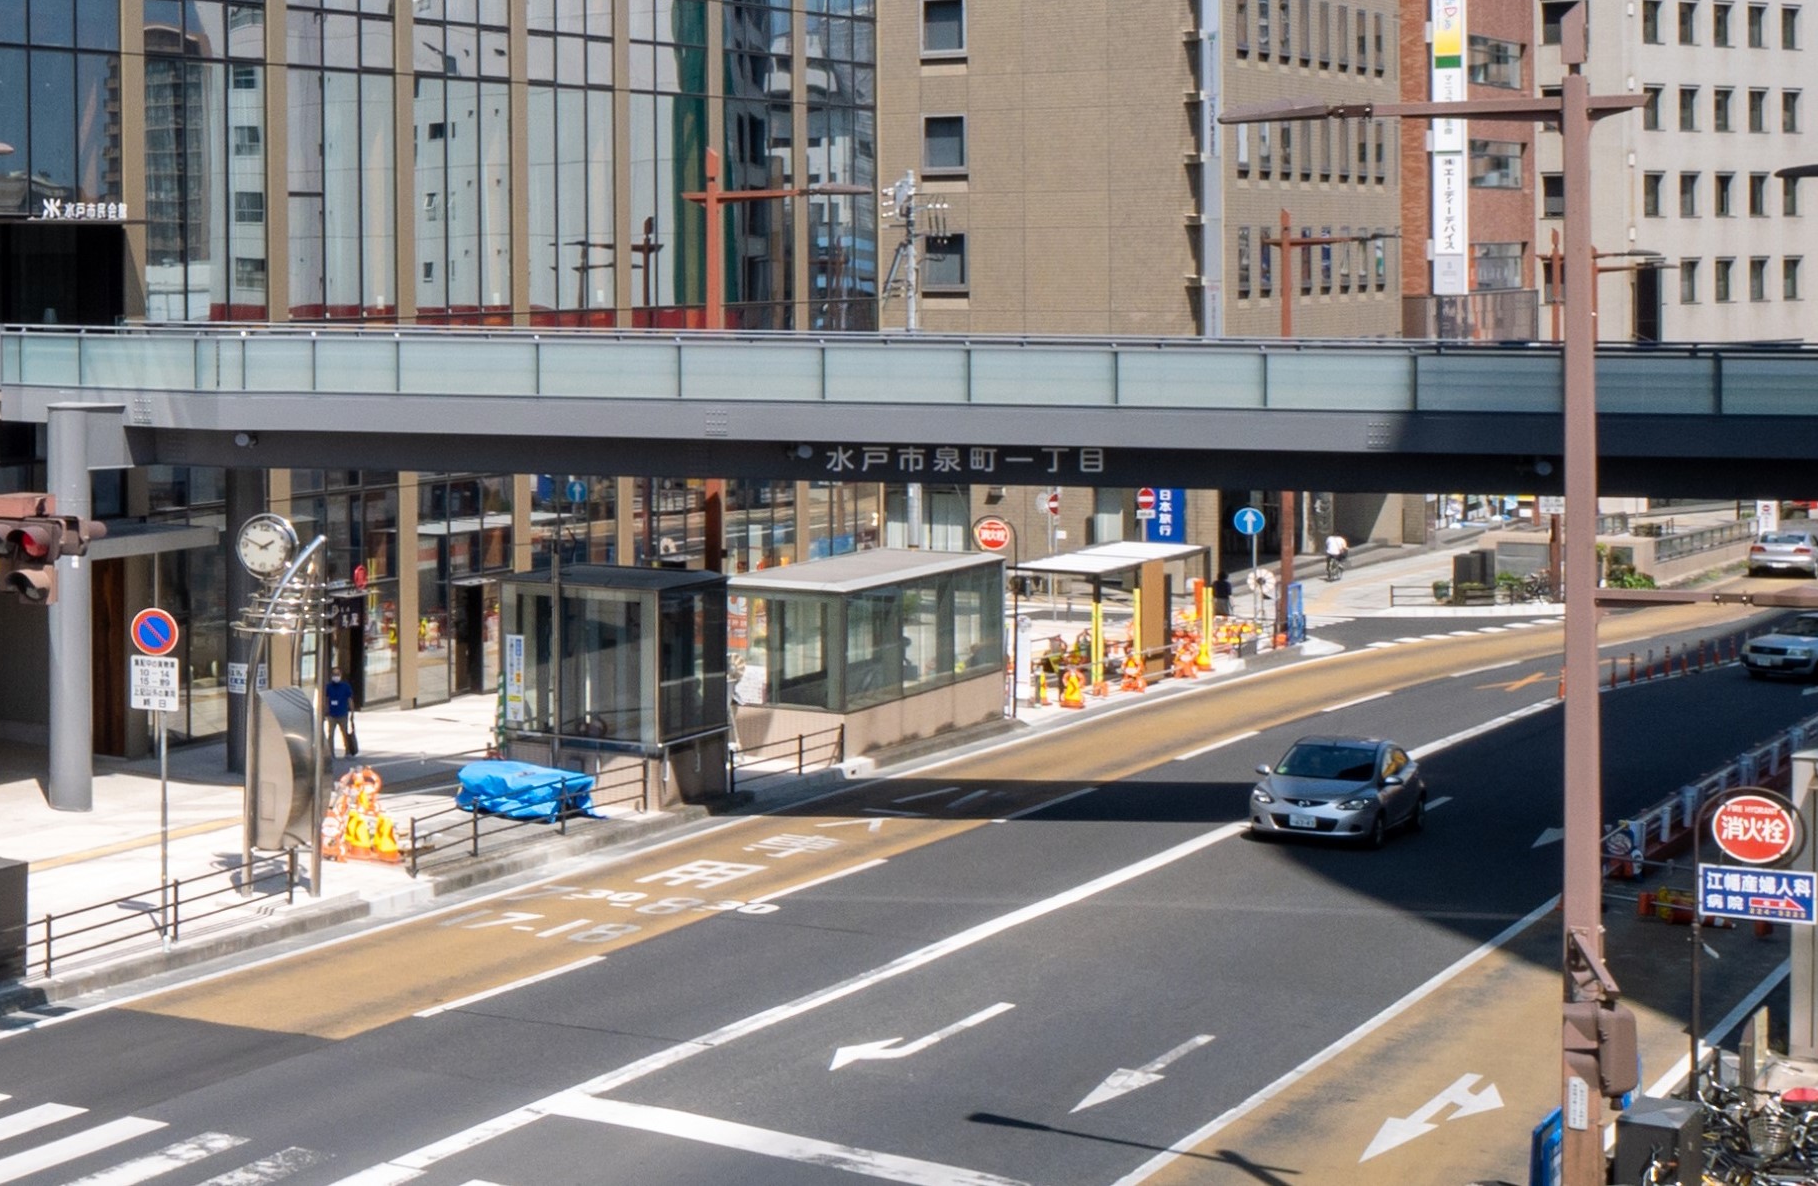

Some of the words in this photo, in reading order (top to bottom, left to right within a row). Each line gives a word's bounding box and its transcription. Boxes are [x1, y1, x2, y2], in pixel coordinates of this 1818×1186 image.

[826, 445, 1104, 473] 水戸市泉町一丁目
[1158, 489, 1173, 536] 日本旅行
[1726, 804, 1743, 813] FIRE
[1744, 805, 1779, 815] HYDRANT
[1721, 815, 1786, 844] 消火栓
[1706, 893, 1744, 911] 病院
